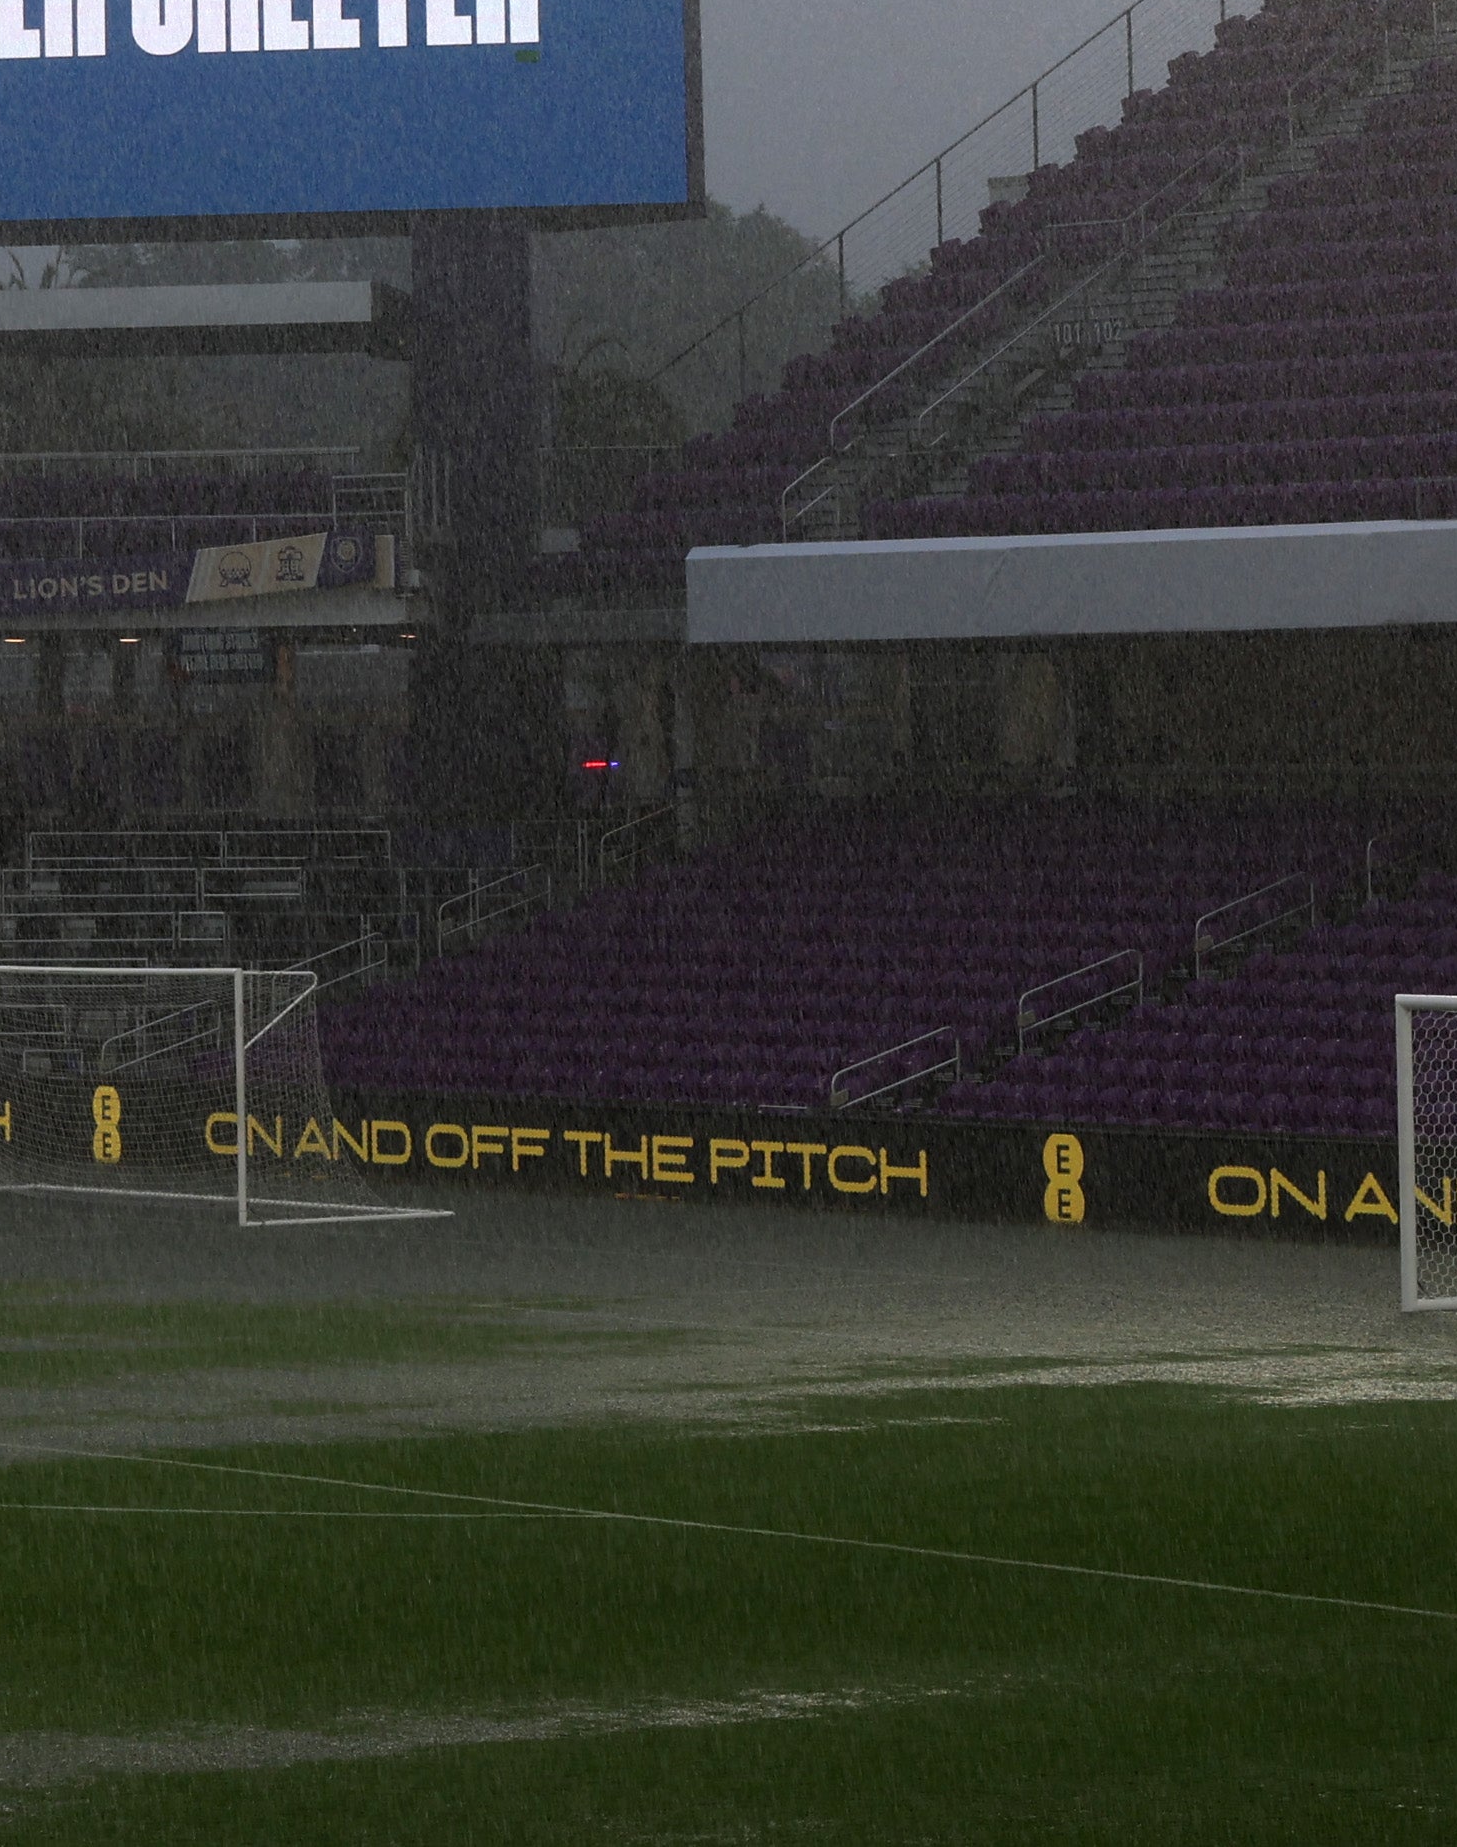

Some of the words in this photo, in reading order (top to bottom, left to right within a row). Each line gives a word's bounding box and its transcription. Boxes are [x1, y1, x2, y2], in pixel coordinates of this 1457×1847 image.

[1054, 323, 1081, 343] 101
[1094, 320, 1122, 343] 102
[12, 574, 105, 600] LION'S
[111, 569, 169, 593] DEN
[205, 1112, 283, 1158] ON
[294, 1117, 412, 1165] AND
[425, 1123, 551, 1171] OFF
[563, 1130, 695, 1183] THE
[710, 1139, 928, 1197] PITCH
[1207, 1165, 1327, 1221] ON
